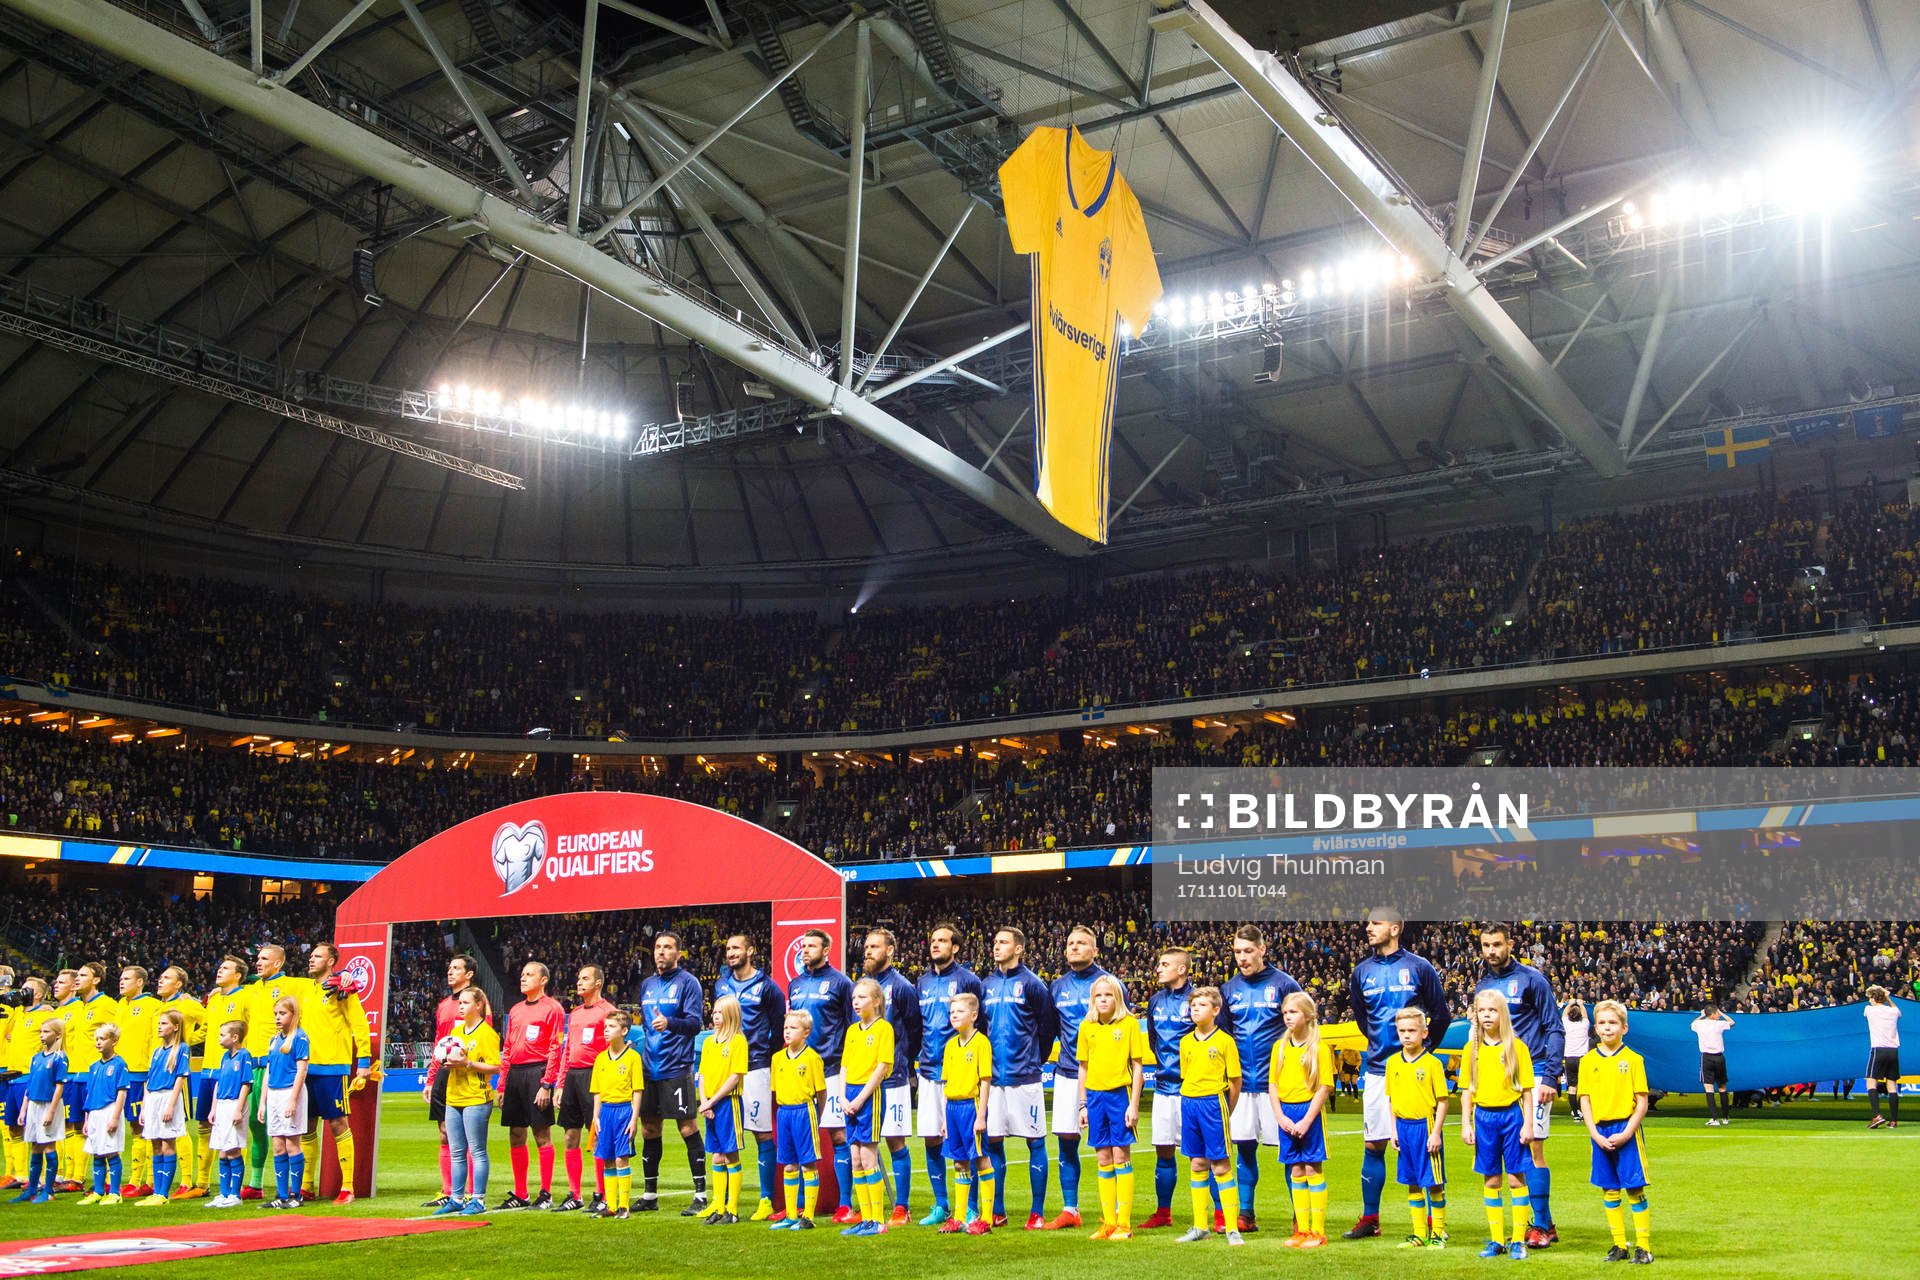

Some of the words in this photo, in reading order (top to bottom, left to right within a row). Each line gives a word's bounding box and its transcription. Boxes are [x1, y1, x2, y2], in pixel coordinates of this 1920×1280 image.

[557, 829, 643, 854] EUROPEAN
[1312, 832, 1408, 851] #viärsverige
[545, 850, 655, 882] QUALIFIERS
[349, 959, 370, 972] UEFA
[674, 1087, 683, 1106] 1
[750, 1100, 760, 1117] 3
[889, 1103, 904, 1122] 16
[1029, 1105, 1038, 1124] 4
